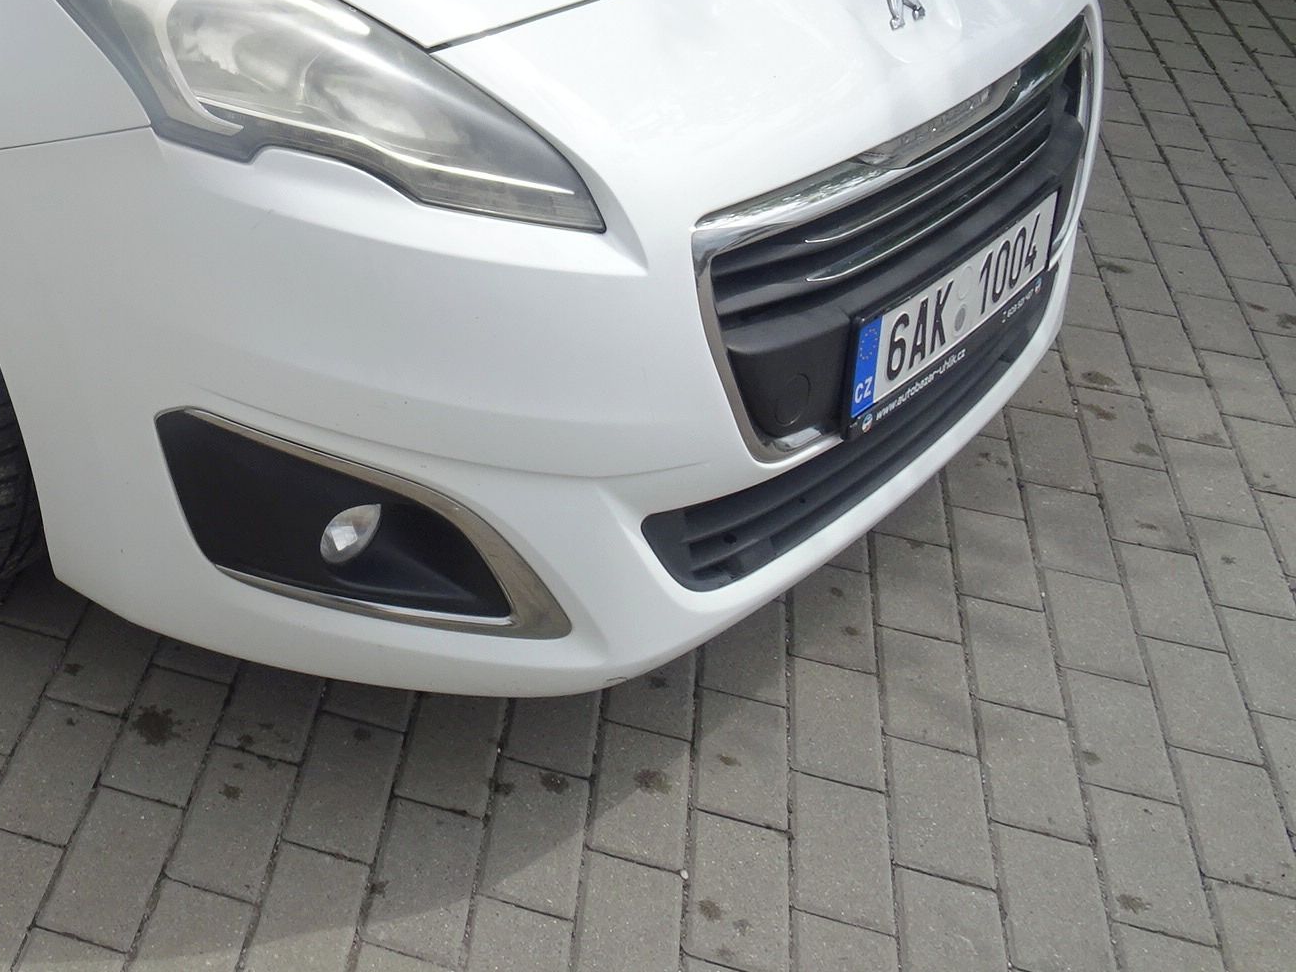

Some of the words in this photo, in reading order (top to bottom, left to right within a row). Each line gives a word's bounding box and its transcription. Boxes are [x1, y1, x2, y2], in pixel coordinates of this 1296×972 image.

[886, 278, 954, 381] 6AK
[979, 212, 1041, 315] 1004
[854, 376, 873, 404] CZ
